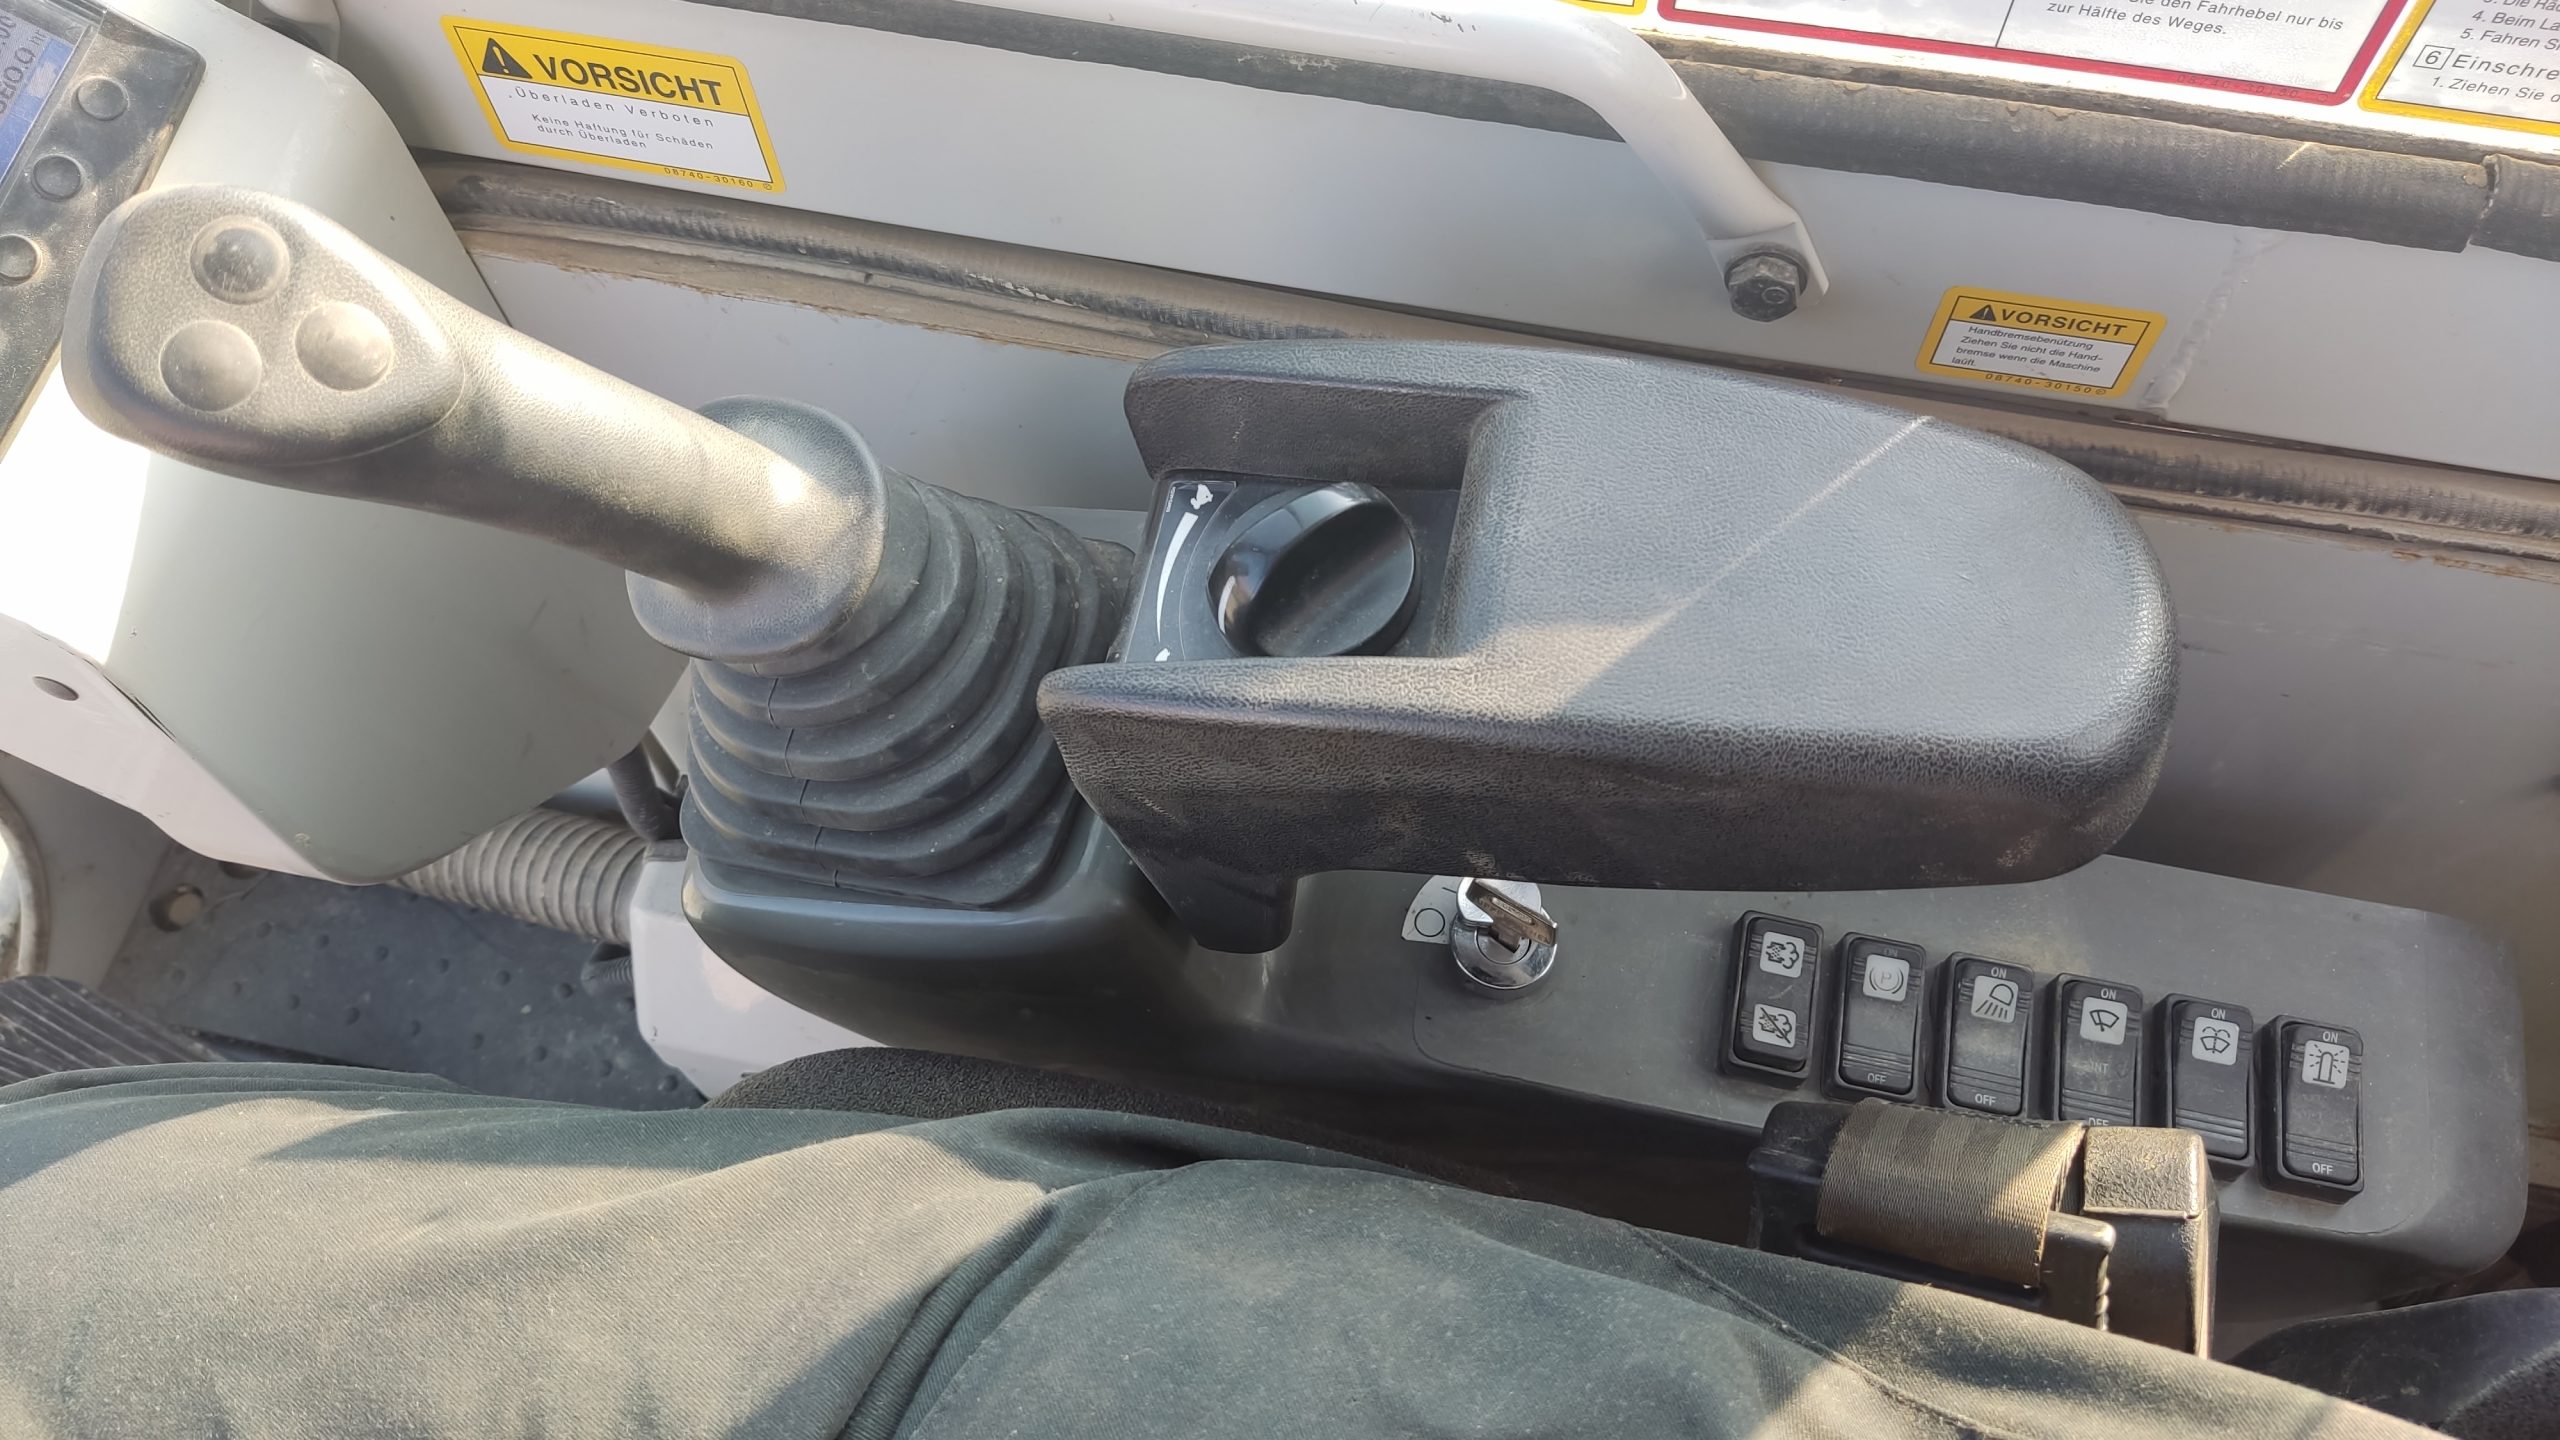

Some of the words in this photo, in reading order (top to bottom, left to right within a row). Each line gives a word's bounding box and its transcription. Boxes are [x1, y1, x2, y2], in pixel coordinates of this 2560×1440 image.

[2046, 2, 2073, 14] zur
[2079, 4, 2126, 21] Hälfte
[2132, 12, 2161, 25] des
[2168, 16, 2227, 34] Weges.
[2196, 0, 2281, 22] Fahrhebel
[2286, 13, 2315, 29] nur
[2318, 16, 2344, 31] bis
[2472, 10, 2486, 22] 4.
[2491, 11, 2536, 28] Beim
[2460, 28, 2474, 40] 5.
[2480, 30, 2540, 48] Fahren
[2424, 50, 2442, 65] 6
[532, 54, 721, 106] VORSICHT
[2432, 76, 2443, 87] 1.
[2448, 78, 2510, 97] Ziehen
[2515, 86, 2545, 101] Sie
[515, 86, 614, 111] Überladen
[624, 103, 714, 127] Verboten
[531, 113, 569, 126] Keine
[575, 120, 627, 137] Haftung
[631, 129, 649, 139] für
[655, 133, 713, 149] Schäden
[537, 124, 573, 137] durch
[579, 129, 647, 149] Überladen
[664, 167, 753, 188] 08740-30160
[2001, 309, 2127, 336] VORSICHT
[1960, 335, 1998, 347] Ziehen
[2000, 341, 2018, 350] Sie
[2020, 344, 2047, 354] nicht
[2049, 348, 2066, 357] die
[2068, 351, 2103, 361] Hand-
[1956, 346, 1996, 358] bremse
[1999, 353, 2028, 362] wenn
[2030, 357, 2046, 365] die
[2048, 359, 2101, 372] Maschine
[1990, 966, 2007, 979] ON
[2100, 988, 2117, 1000] ON
[2210, 1008, 2226, 1020] ON
[2322, 1031, 2339, 1044] ON
[1867, 1072, 1887, 1085] OFF
[1974, 1093, 1996, 1106] OFF
[2312, 1162, 2333, 1175] OFF
